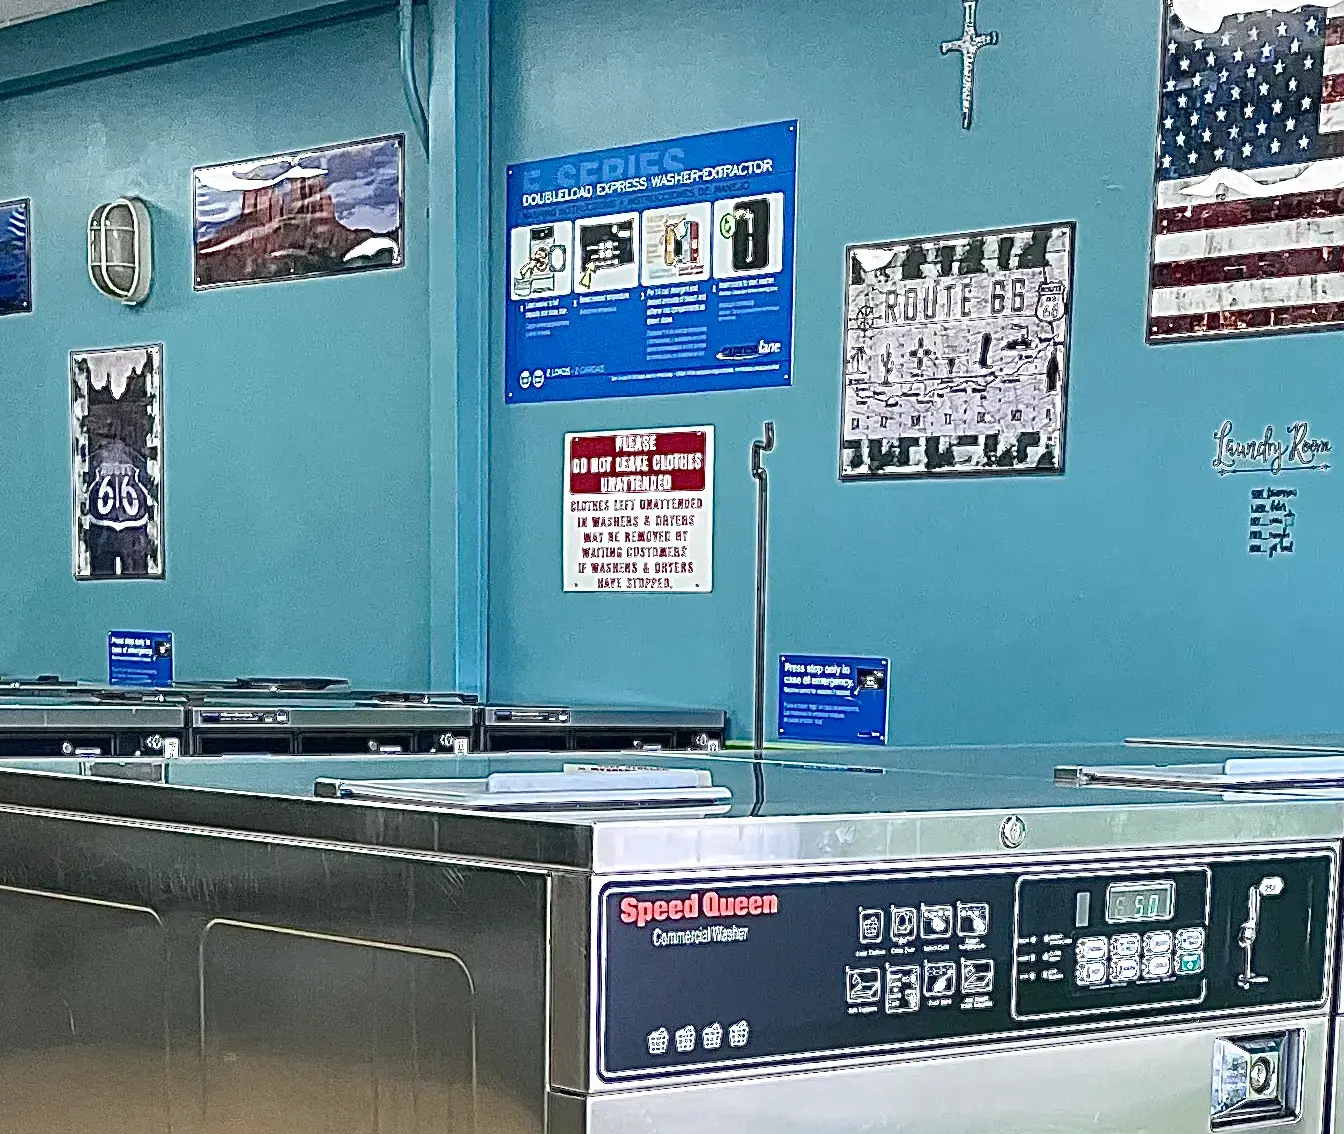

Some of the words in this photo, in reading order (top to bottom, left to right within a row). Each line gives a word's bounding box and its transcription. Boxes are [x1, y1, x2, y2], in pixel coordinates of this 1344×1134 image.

[522, 184, 593, 207] DOUBLELOAD
[597, 177, 647, 198] EXPRESS
[651, 158, 773, 188] WASHER-EXTRACTOR
[885, 283, 972, 323] ROUTE
[991, 278, 1025, 315] 66
[615, 435, 656, 451] PLEASE
[1213, 421, 1288, 475] Laundry
[1287, 422, 1332, 464] Room
[573, 457, 587, 473] DO
[590, 457, 612, 473] NOT
[616, 455, 648, 472] LEAVE
[653, 453, 702, 470] CLOTHES
[601, 475, 672, 492] UNATTENDED
[98, 476, 139, 515] 66
[571, 500, 609, 512] CLOTHES
[614, 499, 635, 511] LEFT
[640, 498, 702, 510] UNATTENDED
[577, 517, 587, 527] IN
[592, 516, 638, 527] WASHERS
[656, 515, 695, 527] DRYERS
[584, 532, 603, 542] MAY
[608, 532, 620, 542] BE
[625, 531, 670, 542] REMOVED
[676, 531, 688, 542] BY
[582, 547, 622, 558] WAITING
[626, 546, 688, 558] CUSTOMERS
[578, 563, 586, 573] IF
[591, 562, 638, 573] WASHERS
[655, 562, 693, 573] DRYERS
[598, 578, 621, 588] HAVE
[784, 662, 805, 673] Press
[620, 893, 699, 927] Speed
[703, 891, 778, 917] Queen
[653, 927, 711, 946] Commercial
[711, 925, 749, 942] Washer
